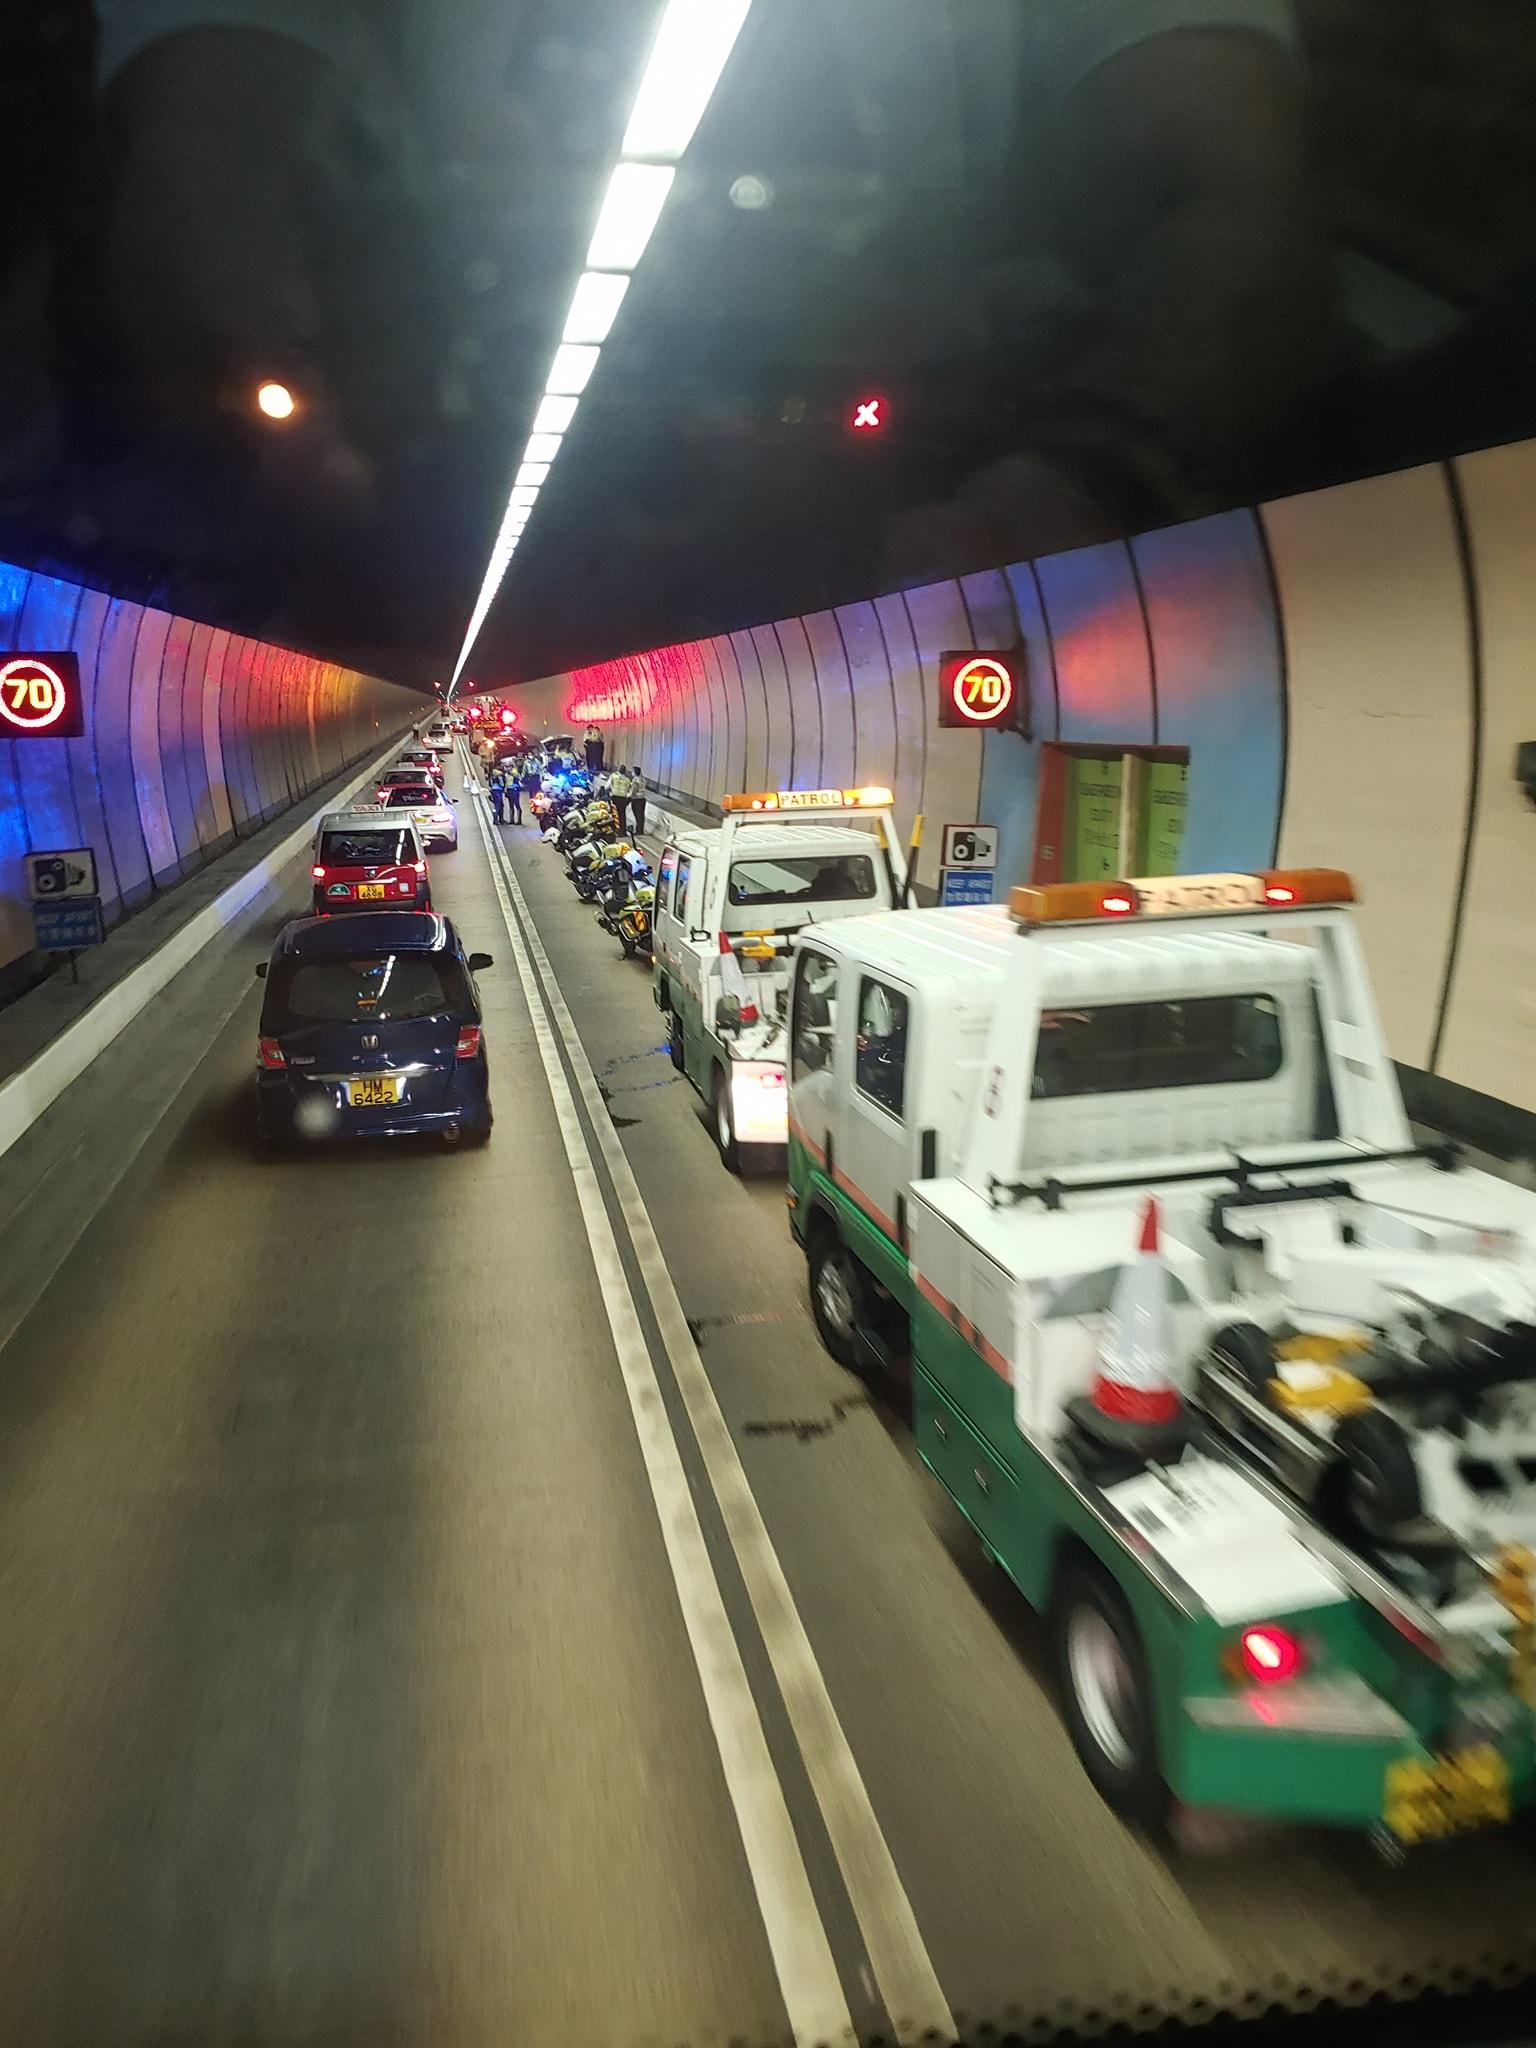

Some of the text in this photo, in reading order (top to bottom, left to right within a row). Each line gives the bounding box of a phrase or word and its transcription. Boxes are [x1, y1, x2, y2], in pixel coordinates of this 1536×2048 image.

[5, 678, 53, 709] 70
[965, 676, 1001, 703] 70
[781, 793, 841, 806] PATROL
[363, 1079, 382, 1093] HM
[354, 1091, 393, 1105] 6422
